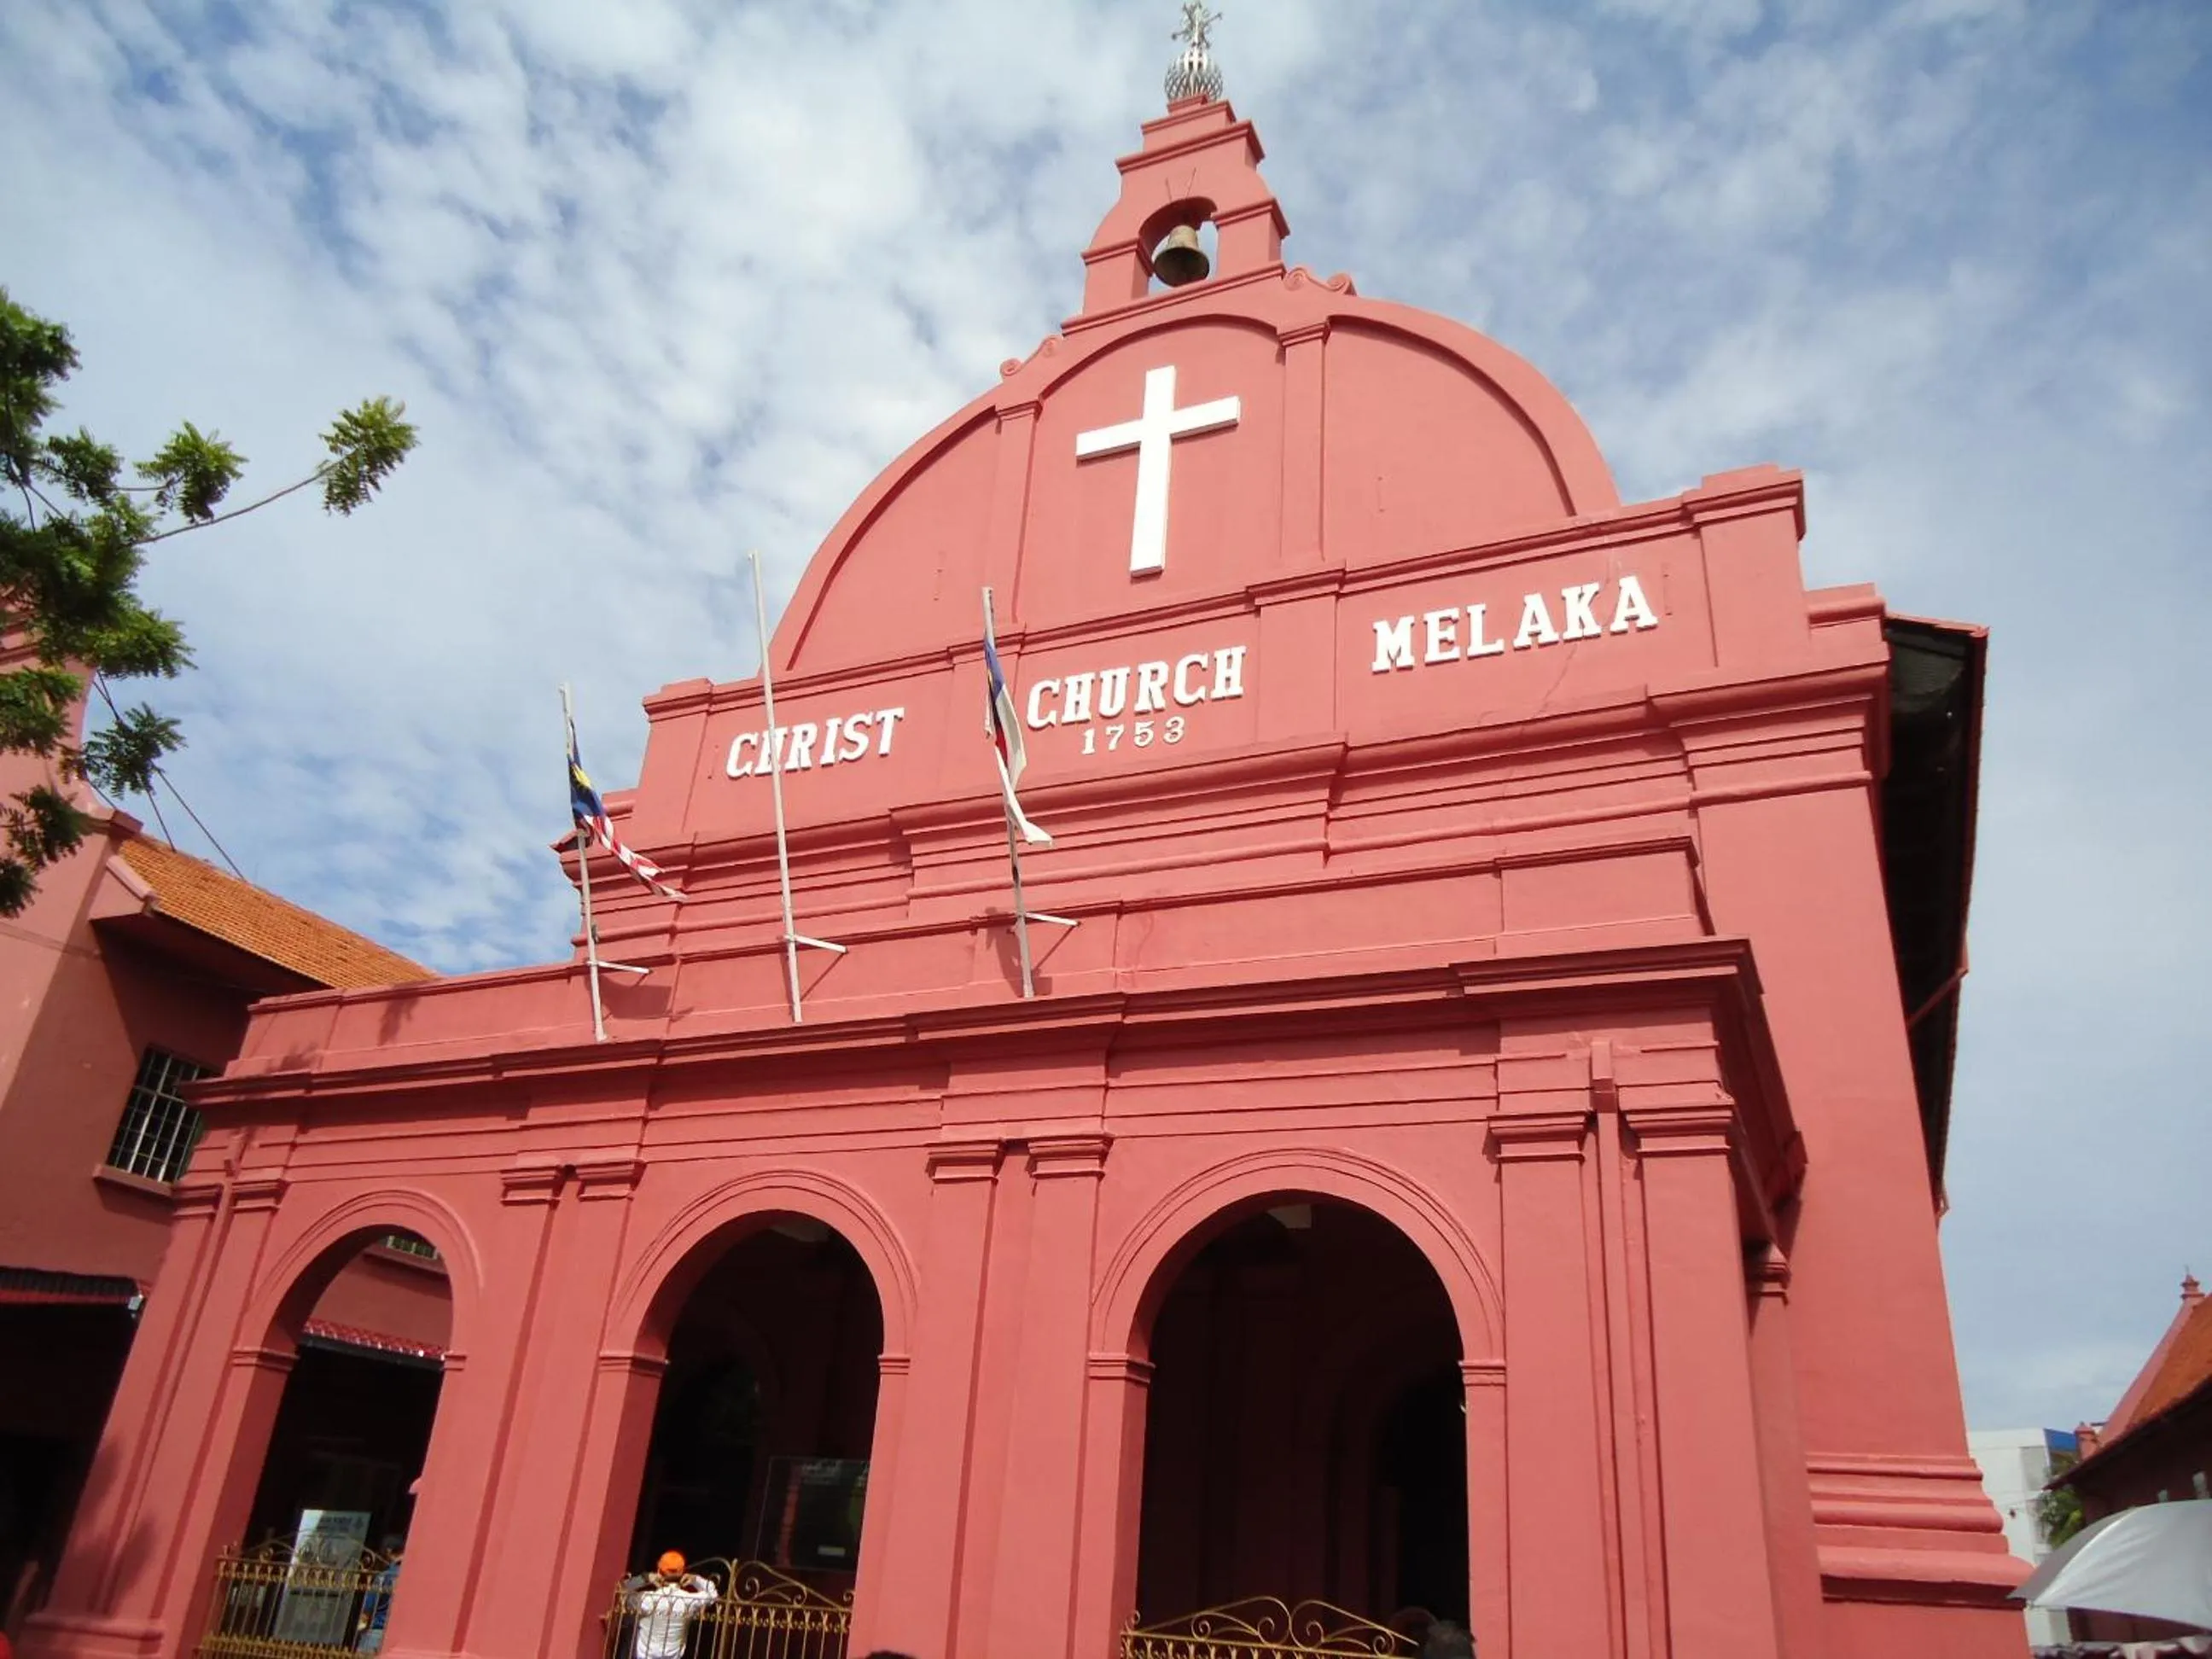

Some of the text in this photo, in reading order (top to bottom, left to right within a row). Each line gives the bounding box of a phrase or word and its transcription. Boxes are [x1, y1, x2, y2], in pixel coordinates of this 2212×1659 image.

[726, 575, 1658, 778] CHRIST CHURCH MELAKA
[1081, 716, 1185, 754] 1753
